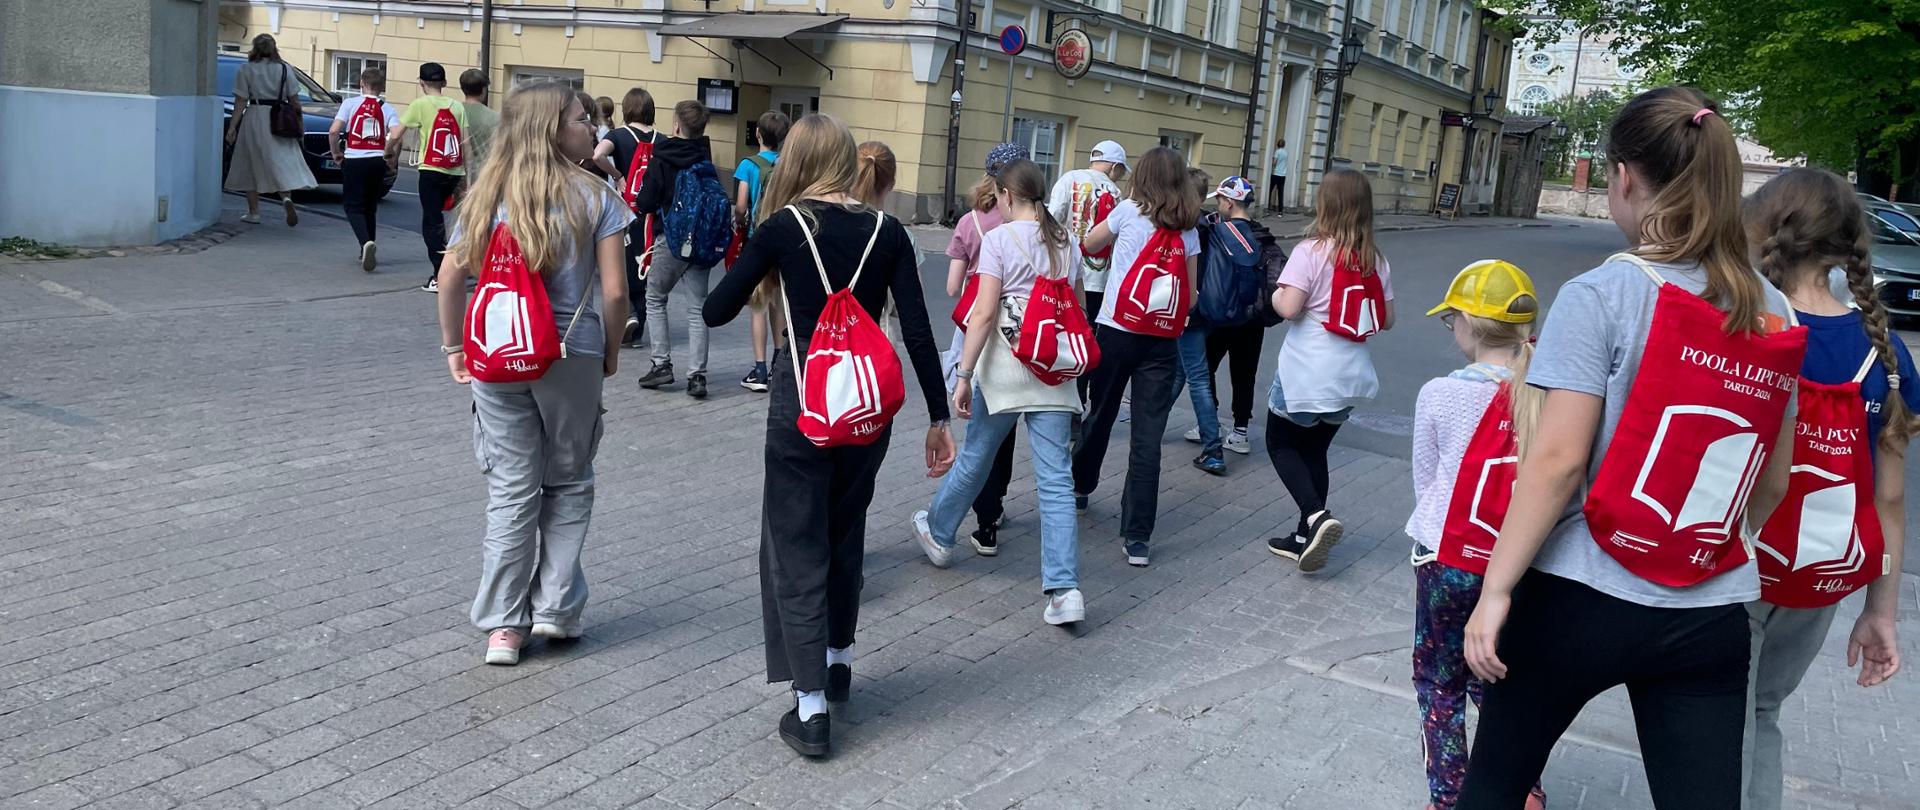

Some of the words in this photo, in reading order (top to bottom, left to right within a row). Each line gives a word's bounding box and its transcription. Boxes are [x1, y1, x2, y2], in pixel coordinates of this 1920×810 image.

[1680, 345, 1740, 377] POOLA
[1744, 364, 1778, 386] LIPU
[1723, 379, 1754, 395] TARTU
[1753, 388, 1771, 401] 2024
[1829, 446, 1852, 455] 2024
